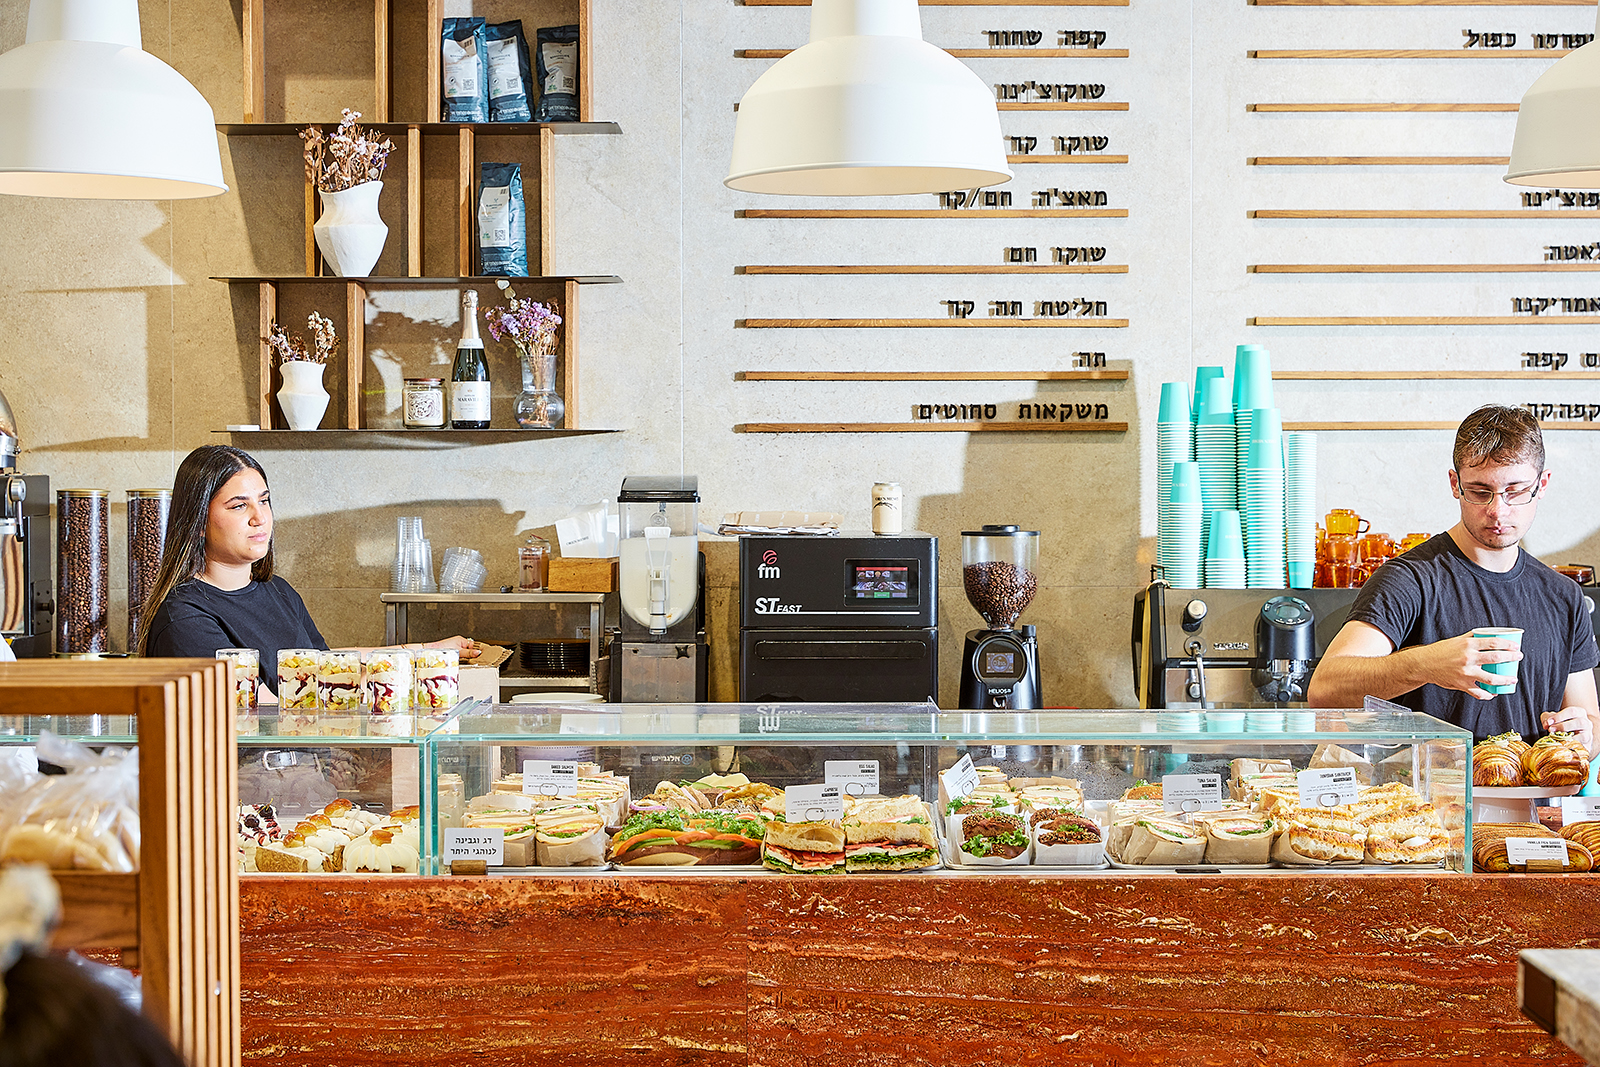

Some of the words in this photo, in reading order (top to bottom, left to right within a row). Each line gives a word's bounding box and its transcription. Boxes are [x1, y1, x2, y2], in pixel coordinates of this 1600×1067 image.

[988, 30, 1042, 46] שחור
[1064, 30, 1106, 49] קפה
[1468, 30, 1516, 48] כפול
[1000, 81, 1105, 102] שוקוצ'ינו
[1010, 136, 1037, 155] קר
[1058, 136, 1108, 155] שוקו
[1038, 188, 1107, 206] מאצ'ה
[1010, 246, 1037, 262] חם
[1057, 246, 1106, 265] שוקו
[947, 300, 974, 318] קר
[995, 300, 1022, 316] תה
[1040, 298, 1107, 317] חליטת
[1079, 352, 1106, 368] תה
[1527, 352, 1568, 371] קפה
[920, 403, 997, 420] סחוטים
[1019, 403, 1109, 422] משקאות
[757, 563, 780, 579] fm
[472, 847, 497, 855] לנוהגי
